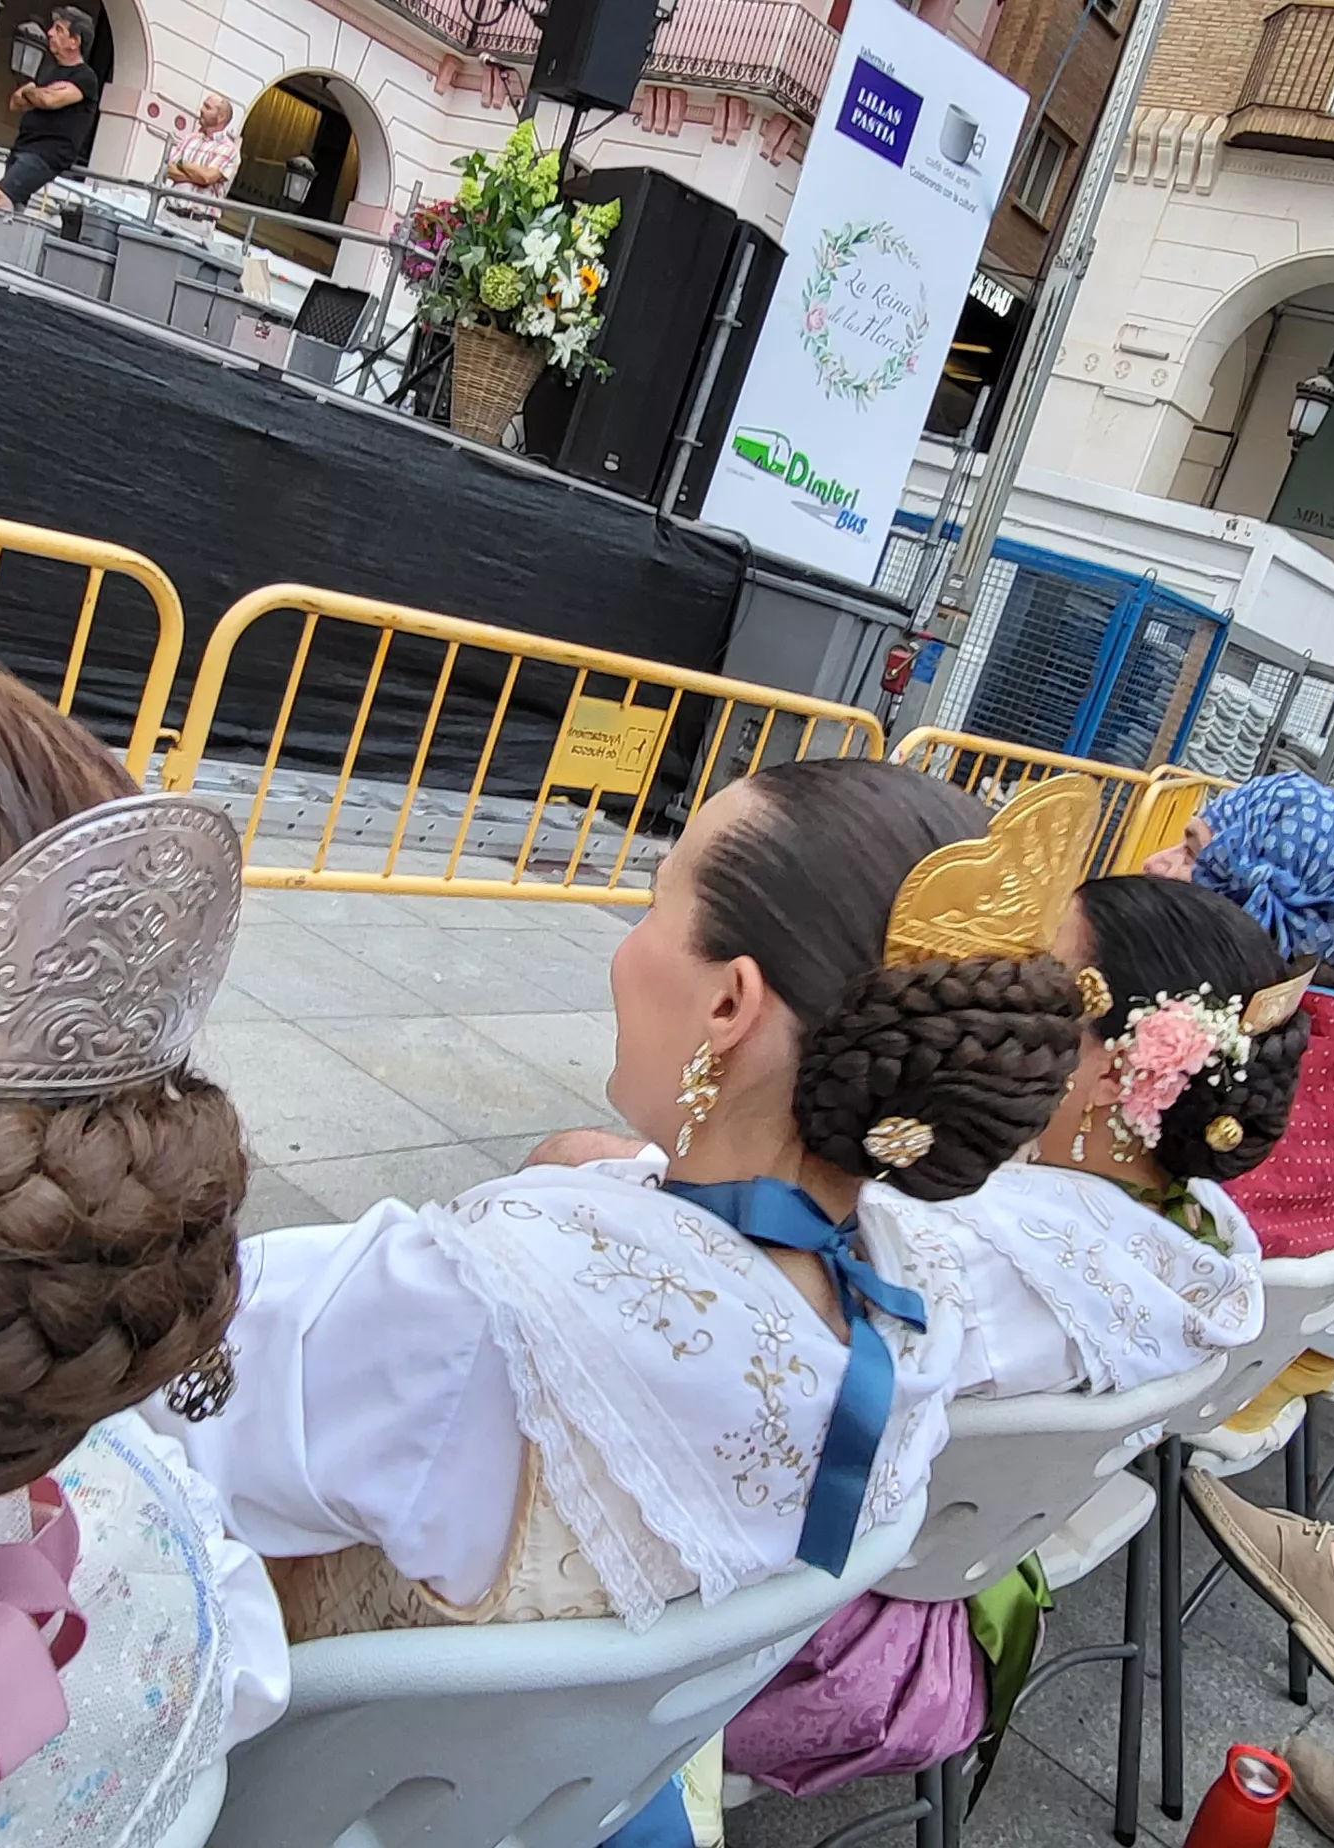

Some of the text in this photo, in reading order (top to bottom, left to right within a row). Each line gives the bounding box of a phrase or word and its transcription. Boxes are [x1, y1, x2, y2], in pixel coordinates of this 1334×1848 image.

[851, 106, 896, 147] PASTIA
[857, 86, 903, 127] LILLAS
[844, 268, 912, 318] La Reina
[969, 270, 1015, 318] ATAU
[828, 304, 845, 325] de
